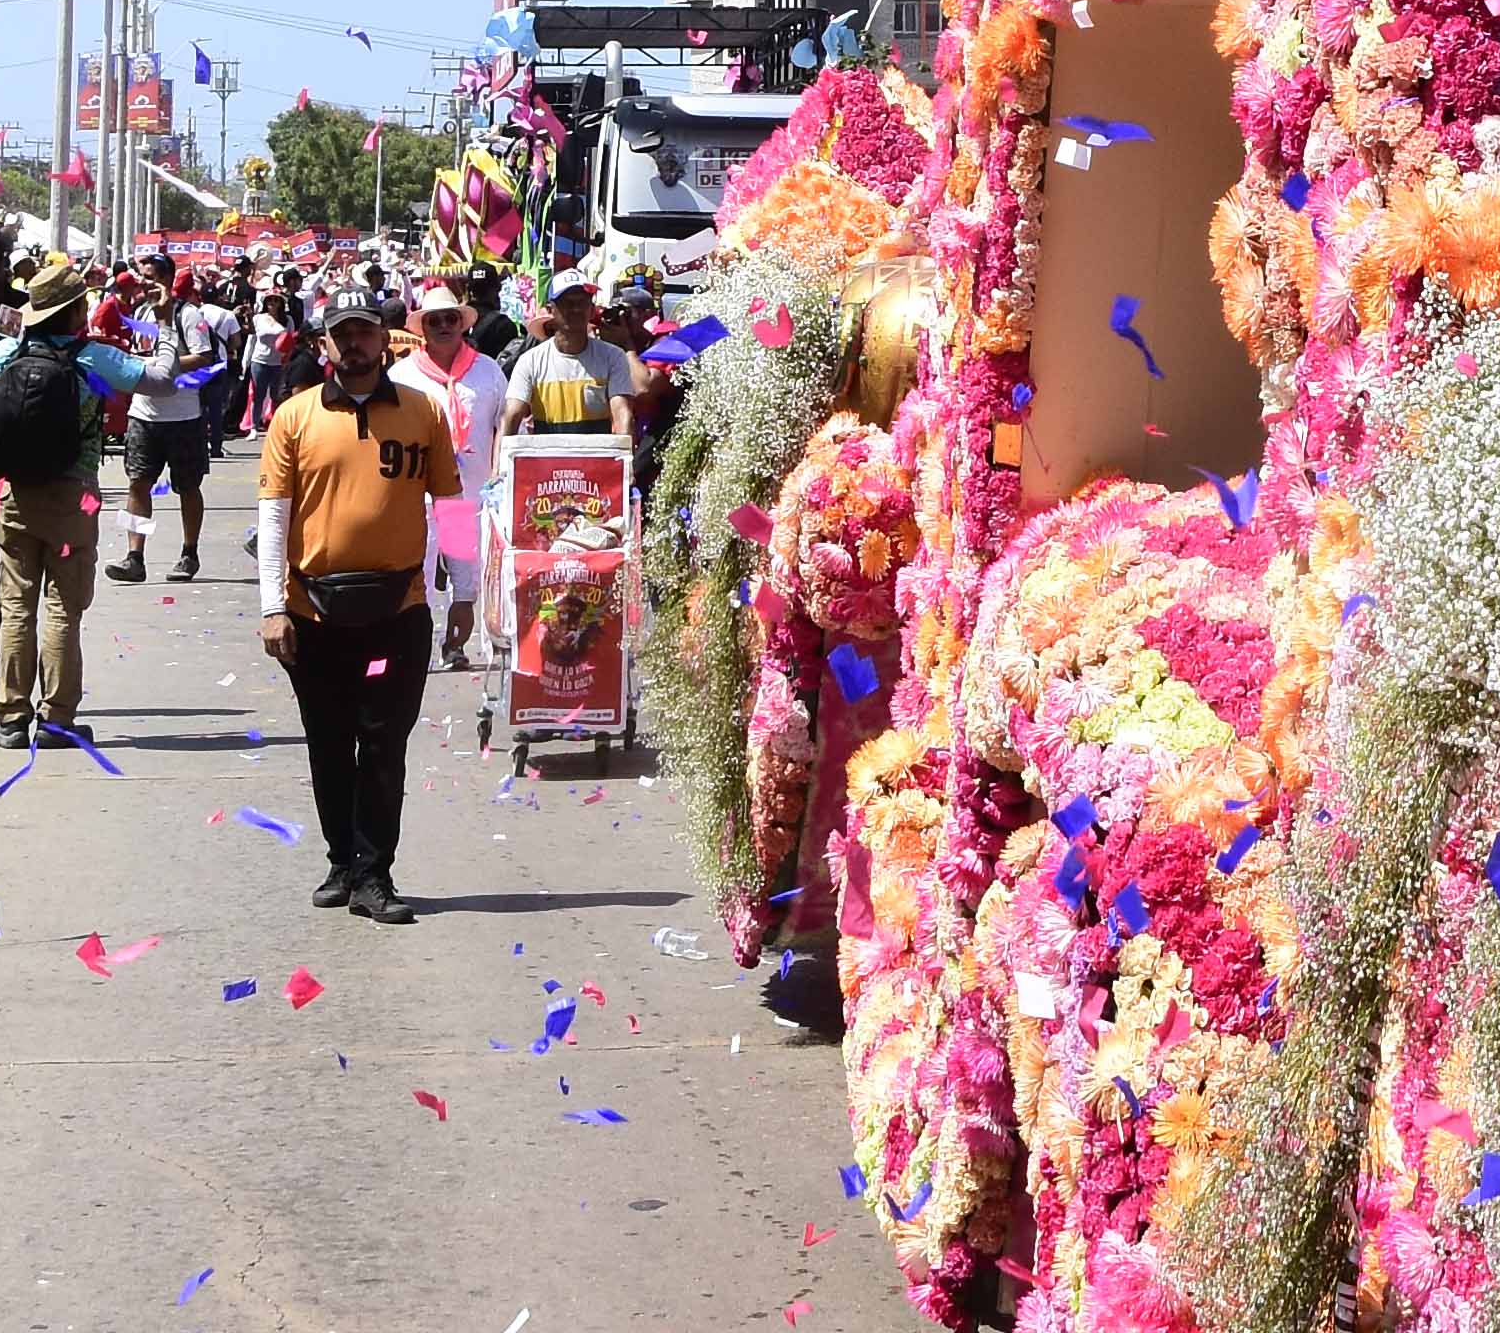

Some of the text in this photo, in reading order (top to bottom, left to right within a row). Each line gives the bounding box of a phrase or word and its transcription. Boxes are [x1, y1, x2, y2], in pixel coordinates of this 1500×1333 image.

[337, 291, 367, 309] 911
[379, 439, 430, 480] 911
[537, 479, 599, 498] BARRANQUILLA
[536, 497, 601, 514] 20 20
[539, 587, 601, 605] 20 20
